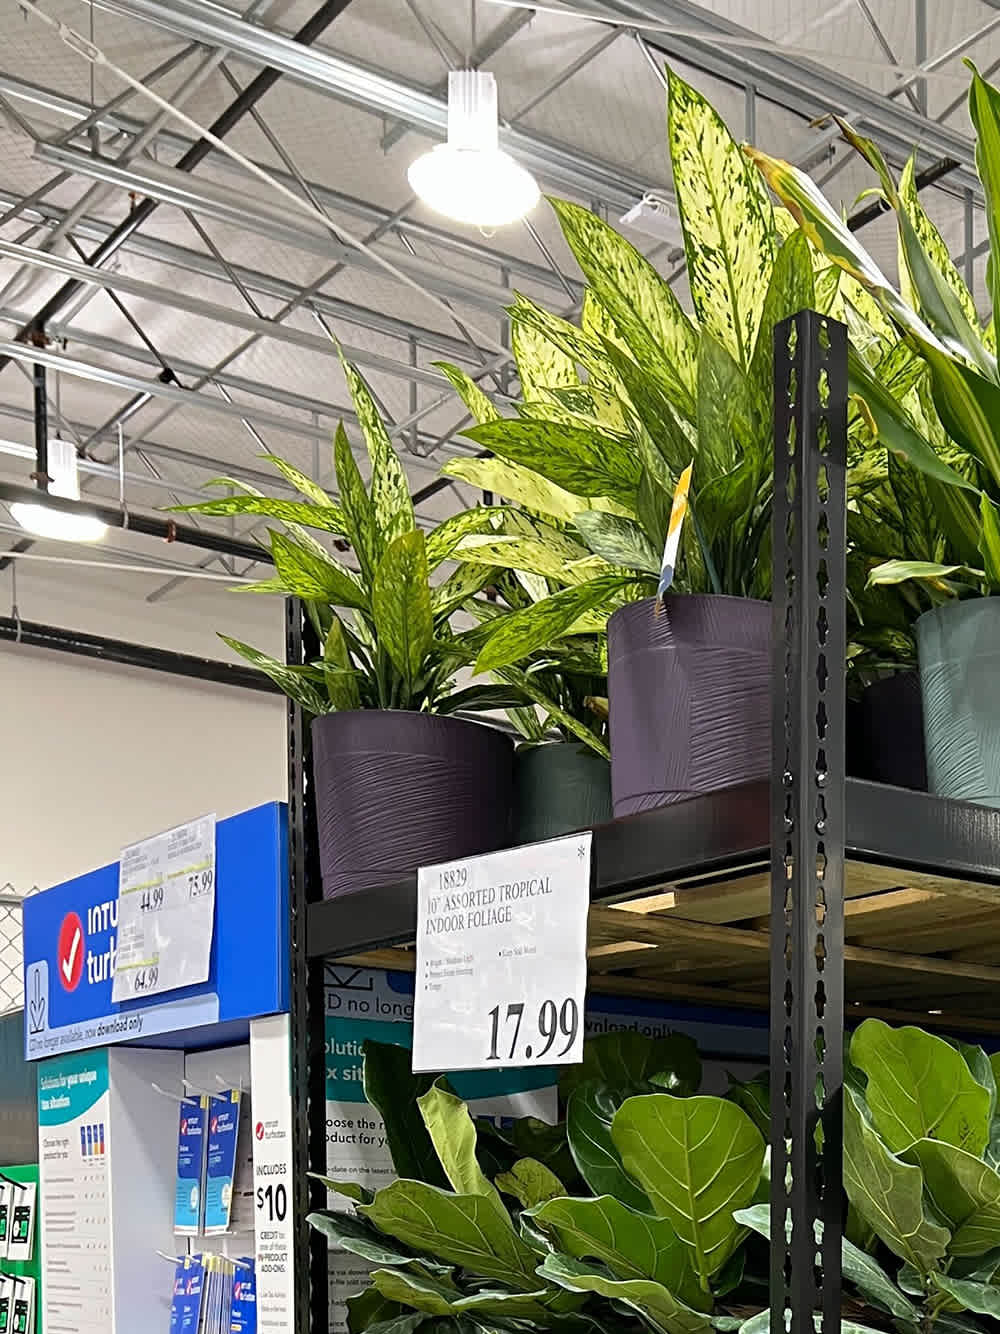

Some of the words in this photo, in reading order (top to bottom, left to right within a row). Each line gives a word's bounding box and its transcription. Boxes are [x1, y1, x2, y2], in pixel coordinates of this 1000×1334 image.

[439, 868, 468, 891] 18829
[443, 888, 496, 913] ASSORTED
[498, 876, 553, 901] TROPICAL
[87, 898, 119, 936] INTU
[425, 914, 465, 935] INDOOR
[467, 906, 512, 930] FOLIAGE
[348, 998, 371, 1013] no
[376, 995, 413, 1020] long
[97, 1017, 128, 1037] download
[129, 1013, 144, 1033] only
[485, 997, 579, 1061] 17.99
[357, 1116, 376, 1129] the
[358, 1134, 374, 1144] for
[257, 1163, 287, 1176] INCLUDES
[257, 1183, 287, 1222] $10
